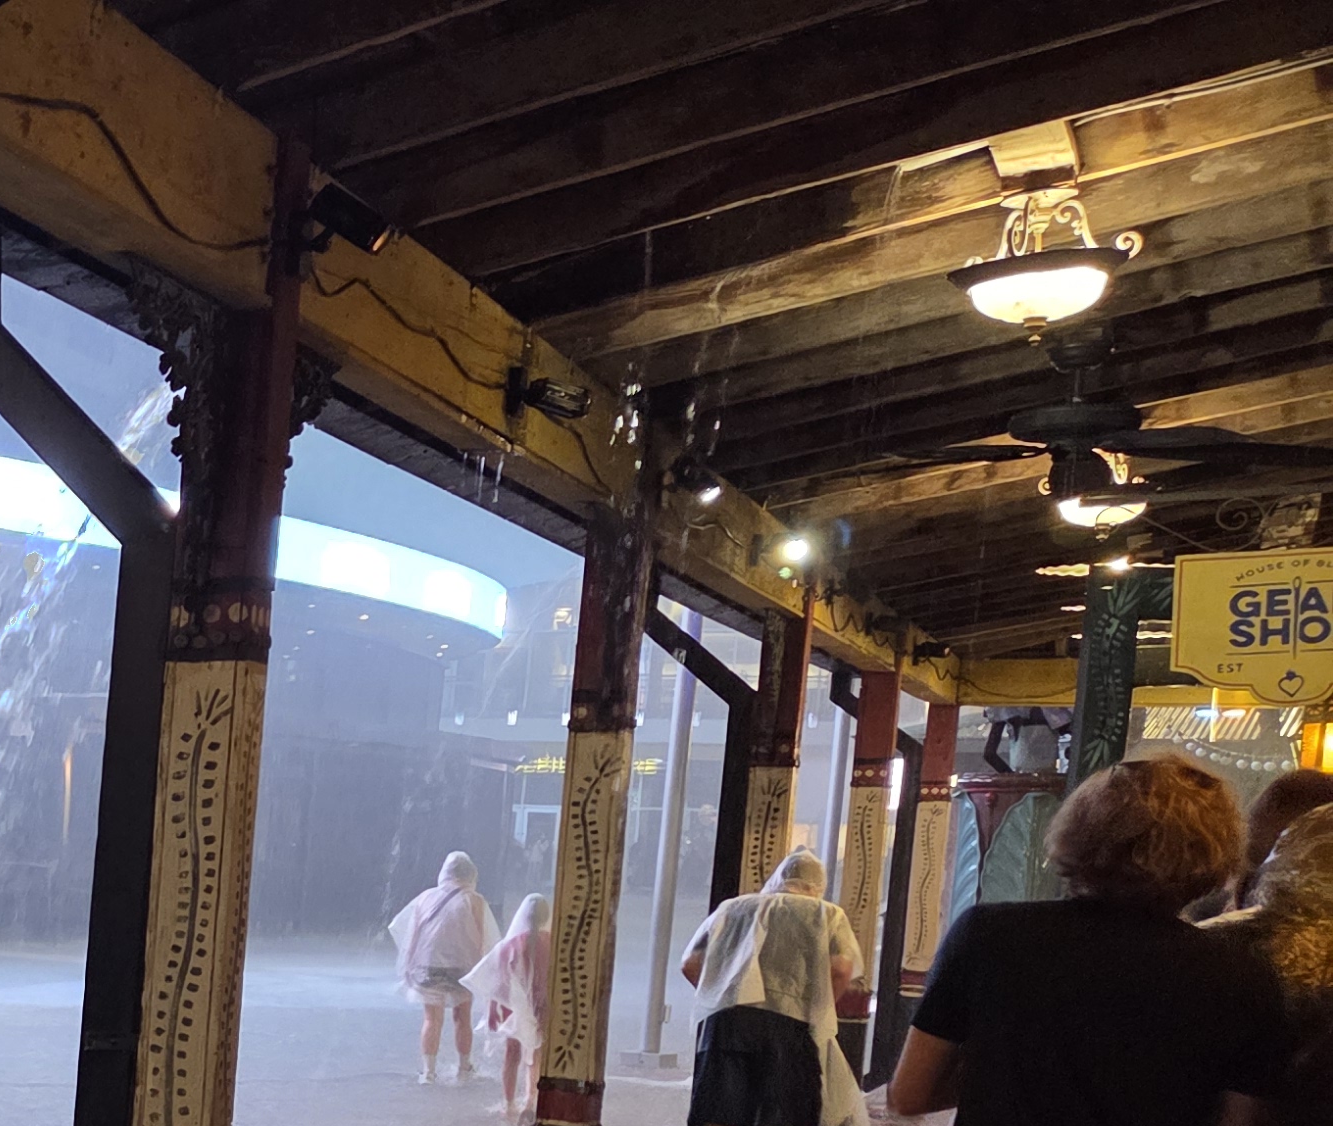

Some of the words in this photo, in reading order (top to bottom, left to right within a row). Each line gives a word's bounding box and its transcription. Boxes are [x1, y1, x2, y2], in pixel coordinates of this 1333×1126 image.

[1235, 561, 1285, 582] HOUSE
[1291, 559, 1311, 567] OF
[1316, 559, 1333, 568] BL
[1229, 586, 1333, 618] GEA
[1229, 615, 1333, 648] SHO
[1217, 663, 1244, 674] EST
